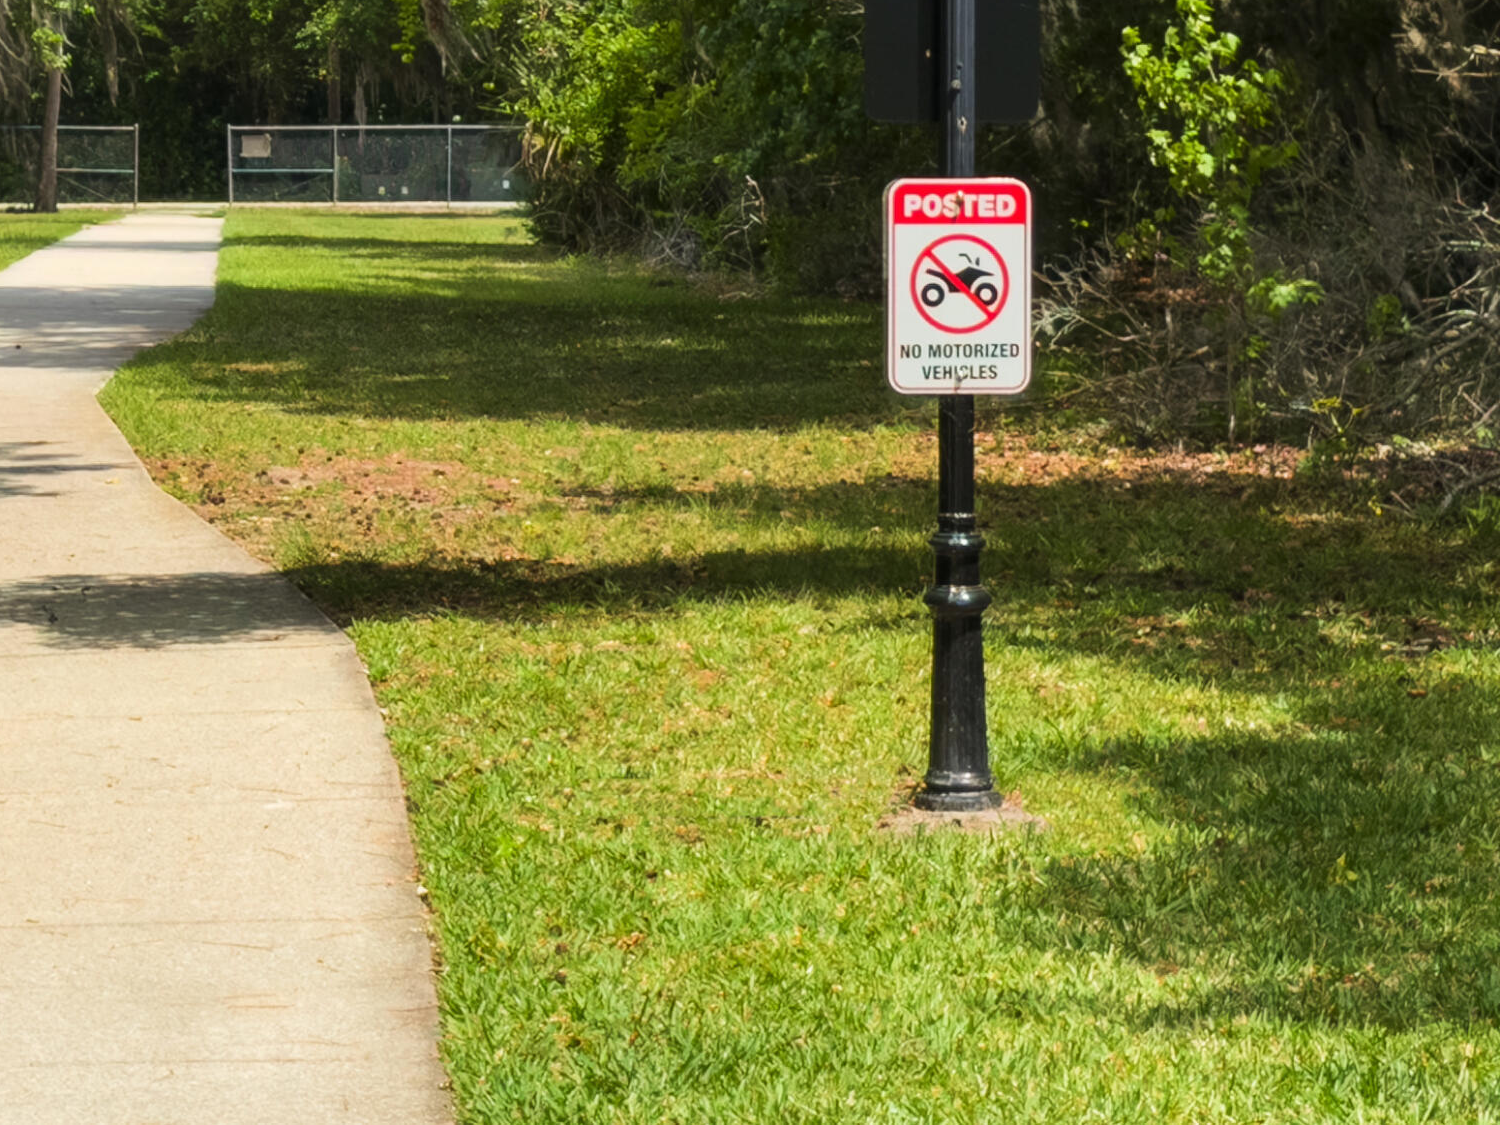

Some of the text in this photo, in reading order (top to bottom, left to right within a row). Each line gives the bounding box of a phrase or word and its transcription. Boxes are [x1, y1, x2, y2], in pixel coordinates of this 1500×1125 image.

[904, 193, 1016, 218] POSTED
[900, 343, 1020, 359] NO MOTORIZED
[922, 365, 998, 380] VEHICLES
